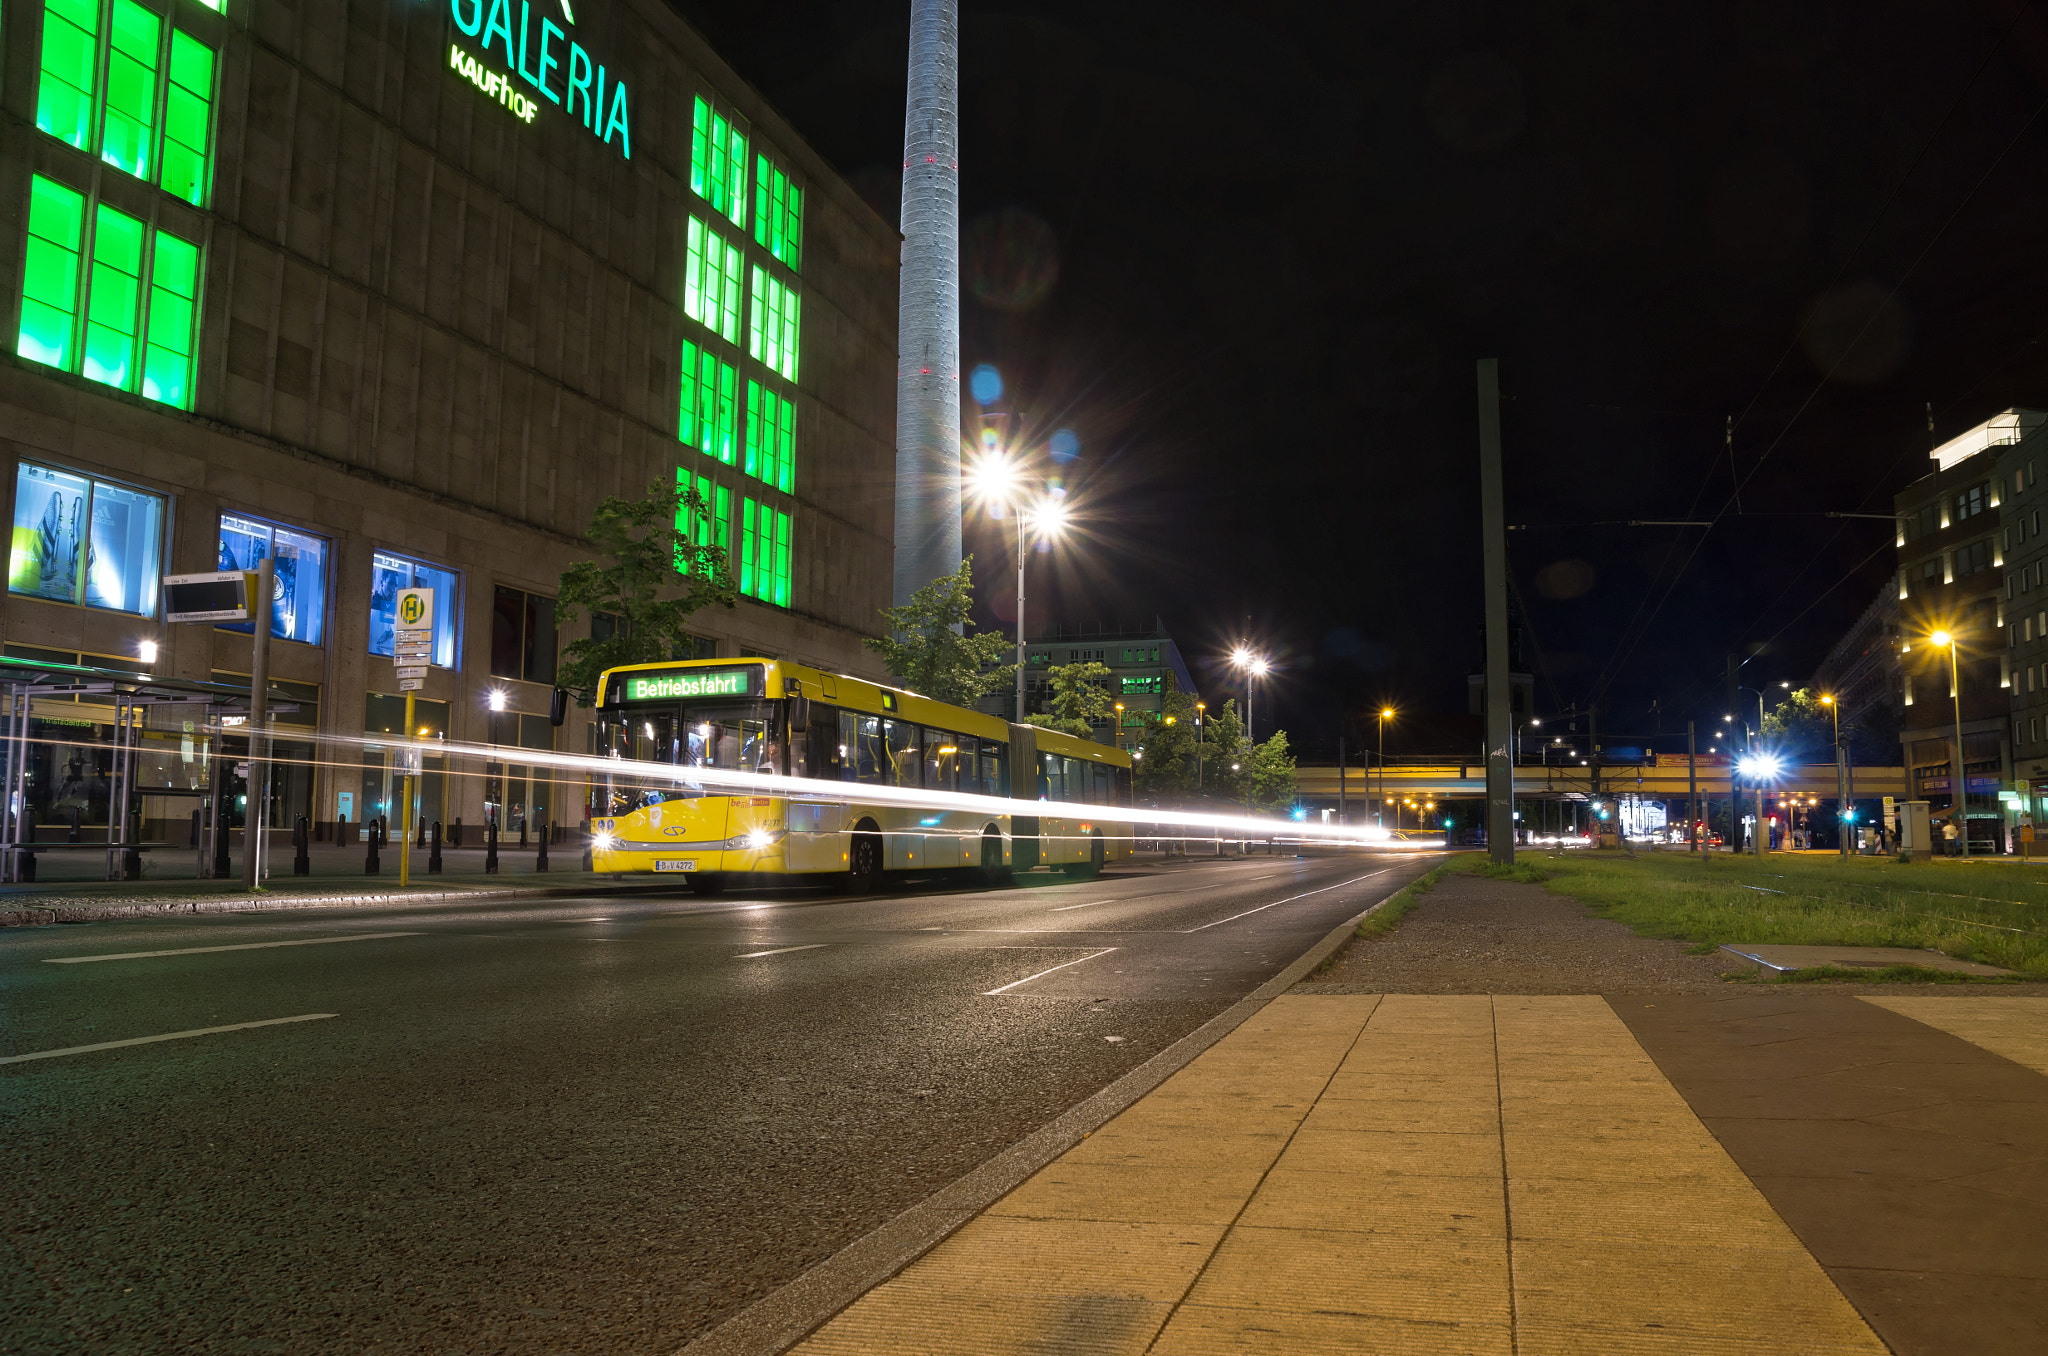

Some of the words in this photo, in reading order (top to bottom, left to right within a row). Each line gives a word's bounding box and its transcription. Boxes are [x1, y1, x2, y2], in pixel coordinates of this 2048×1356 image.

[636, 675, 738, 698] Betriebsfahrt
[763, 819, 781, 827] 4272
[661, 861, 667, 870] B
[675, 861, 693, 870] 4272
